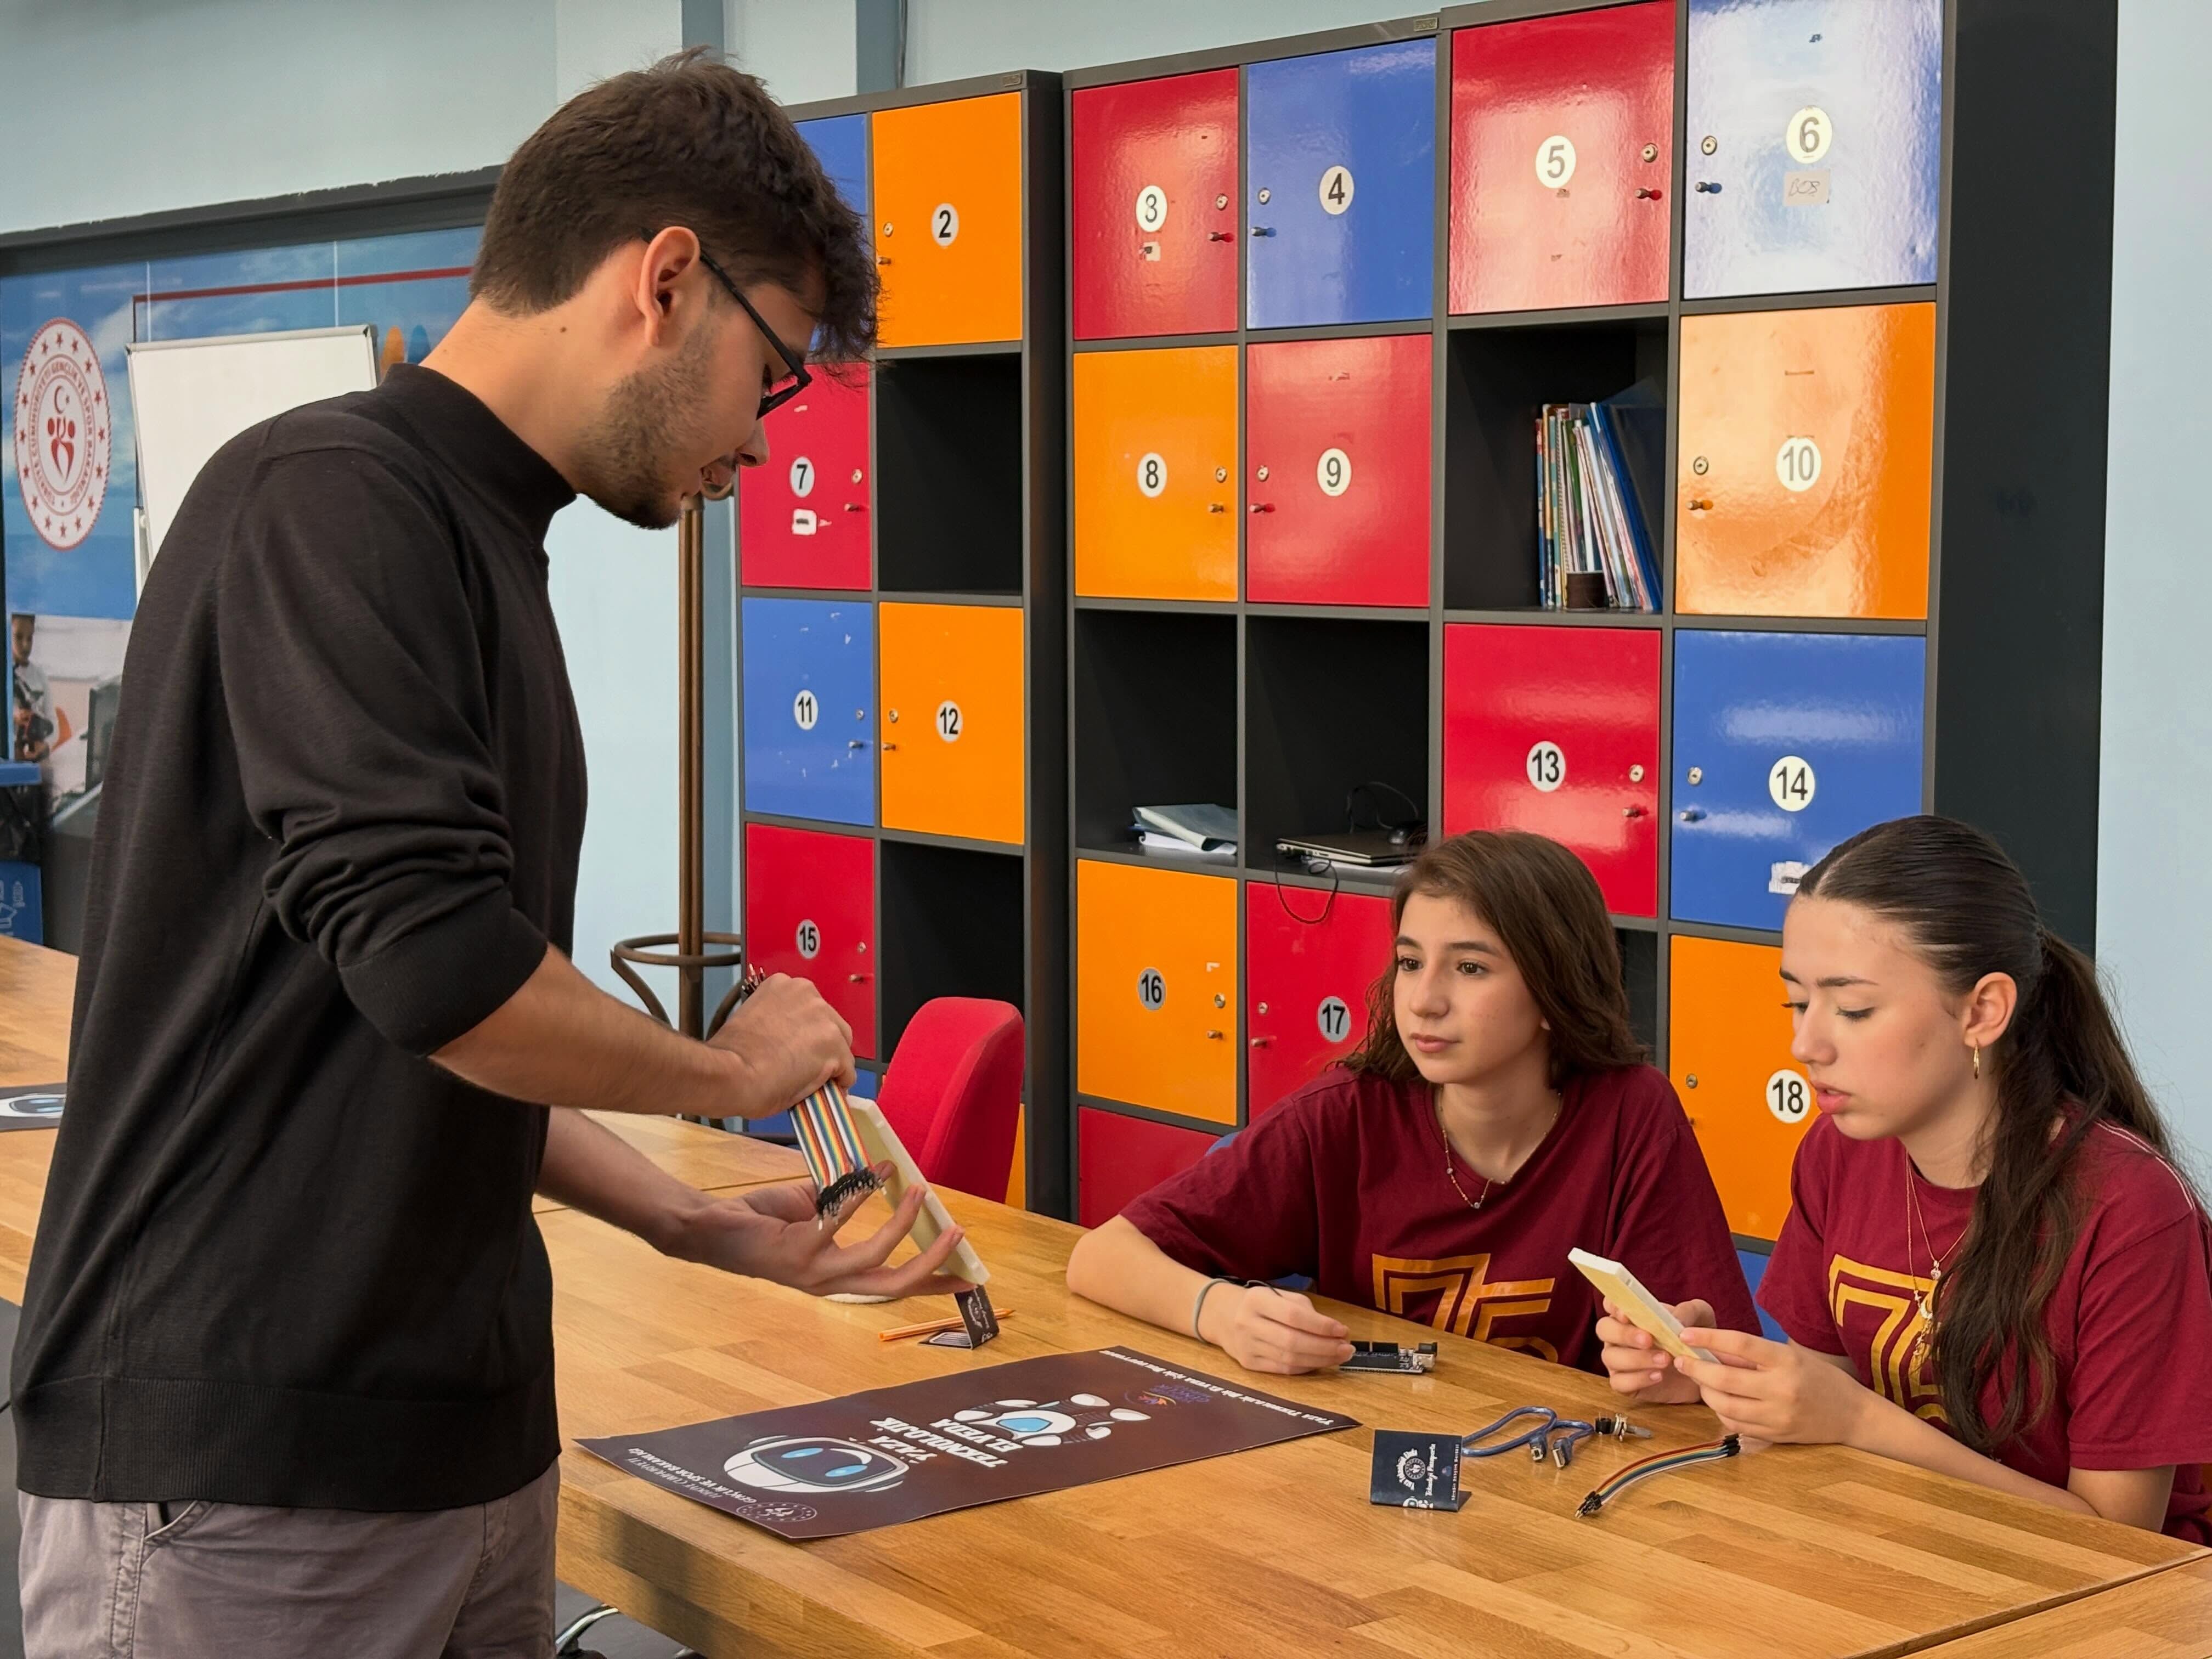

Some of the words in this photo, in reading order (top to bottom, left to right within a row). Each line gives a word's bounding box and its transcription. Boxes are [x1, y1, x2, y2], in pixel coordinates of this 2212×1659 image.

[1799, 116, 1820, 153] 6
[1547, 144, 1565, 179] 5
[1328, 173, 1345, 205] 4
[939, 210, 951, 238] 2
[1145, 194, 1158, 223] 3
[797, 464, 808, 490] 7
[1146, 460, 1159, 489] 8
[1327, 457, 1341, 488] 9
[1783, 445, 1814, 481] 10
[797, 696, 812, 723] 11
[939, 707, 958, 735] 12
[1532, 749, 1560, 783] 13
[1776, 766, 1808, 800] 14
[799, 926, 817, 952] 15
[1141, 974, 1162, 1003] 16
[1322, 1003, 1346, 1035] 17
[1773, 1079, 1803, 1114] 18
[867, 1436, 937, 1460] YAZA
[870, 1417, 1008, 1467] TEKNOLOJİK
[929, 1419, 1023, 1452] ELVEDA
[675, 1469, 705, 1481] SPOR
